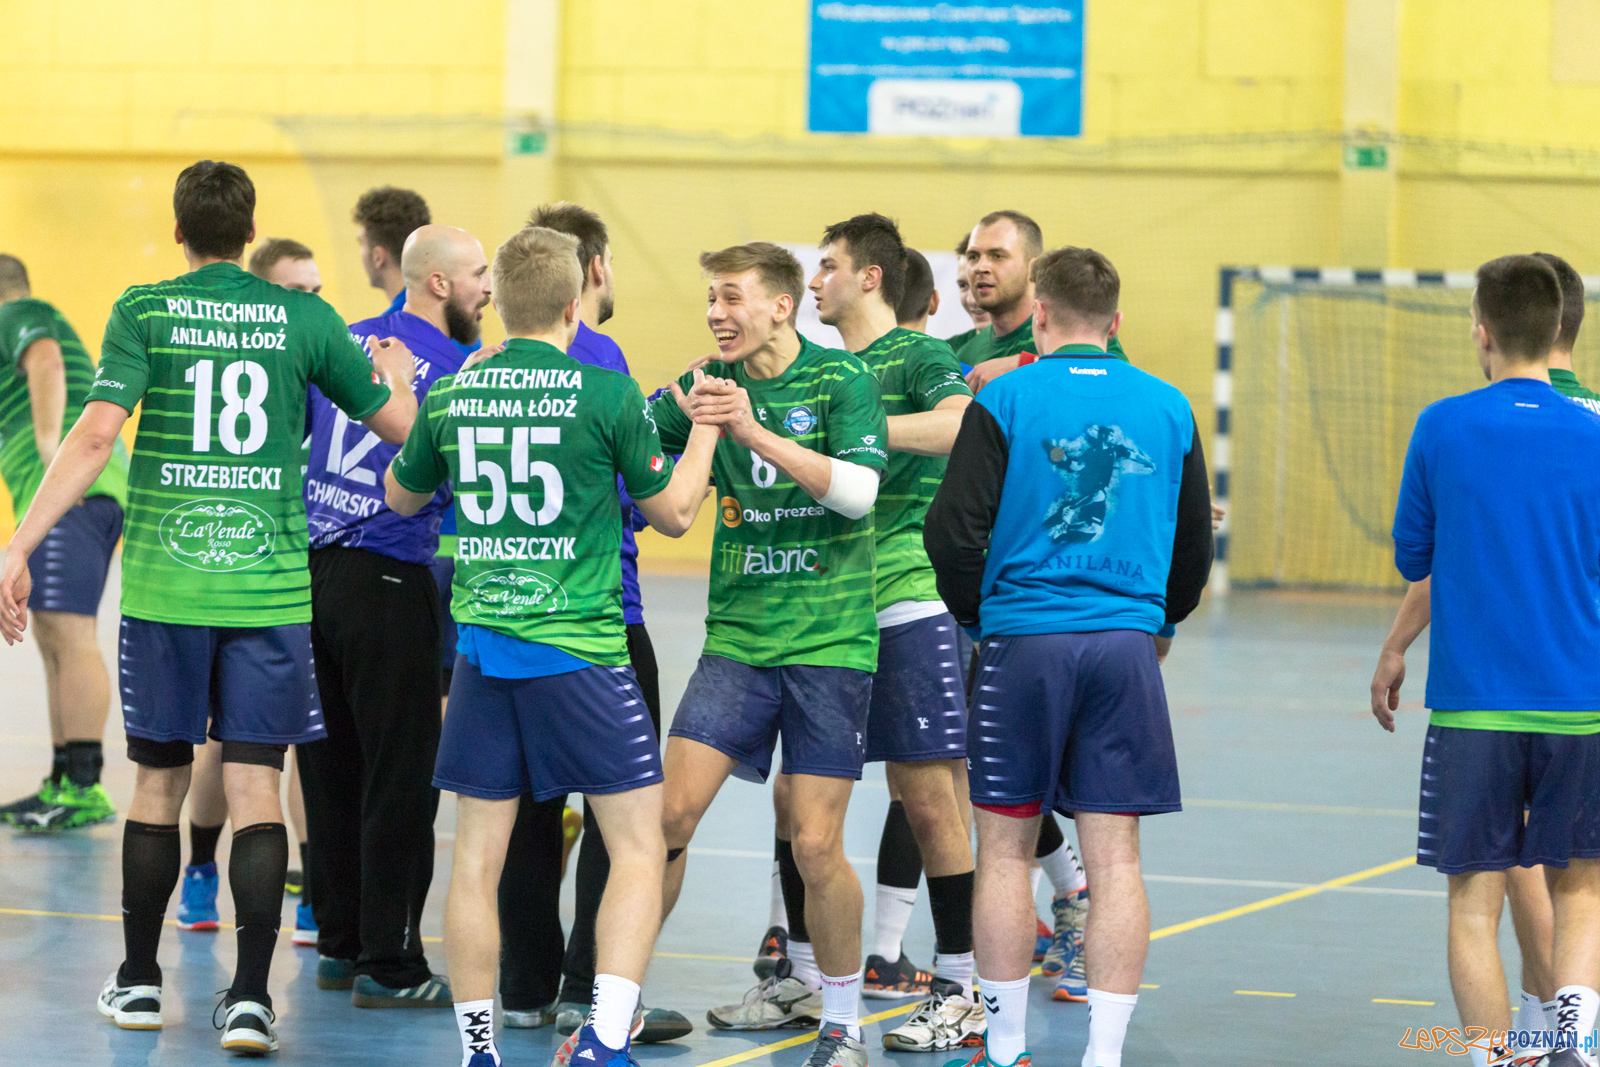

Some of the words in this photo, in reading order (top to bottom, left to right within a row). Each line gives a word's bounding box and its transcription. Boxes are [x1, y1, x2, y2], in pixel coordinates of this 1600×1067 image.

[166, 297, 288, 324] POLITECHNIKA
[170, 326, 238, 349] ANILANA
[241, 327, 286, 350] ŁÓDŹ
[452, 368, 582, 390] POLITECHNIKA
[185, 359, 269, 455] 18
[448, 399, 523, 418] ANILANA
[528, 393, 577, 418] ŁÓDŹ
[160, 463, 282, 490] STRZEBIECKI
[457, 426, 564, 526] 55
[743, 508, 771, 523] Oko
